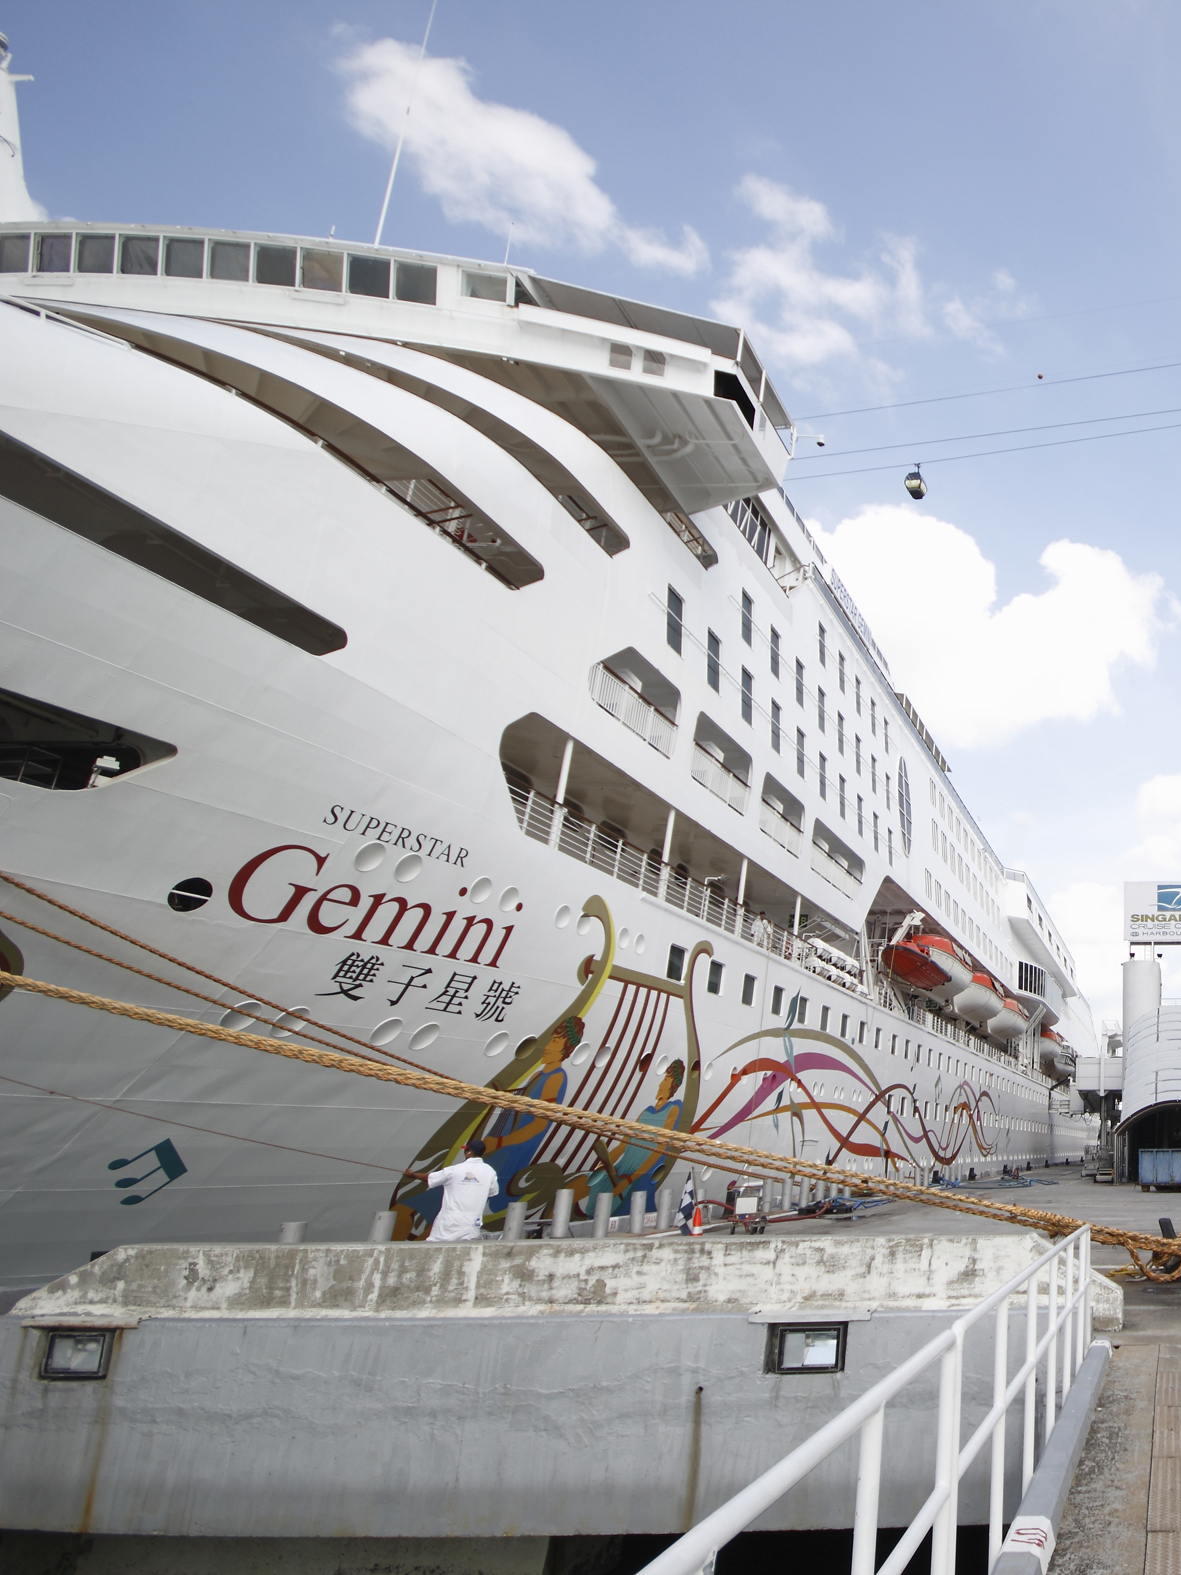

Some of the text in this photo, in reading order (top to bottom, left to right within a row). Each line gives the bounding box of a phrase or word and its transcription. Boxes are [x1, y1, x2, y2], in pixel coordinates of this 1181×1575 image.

[322, 804, 469, 868] SUPERSTAR
[227, 844, 523, 968] Gemini
[315, 951, 521, 1022] 雙子星號
